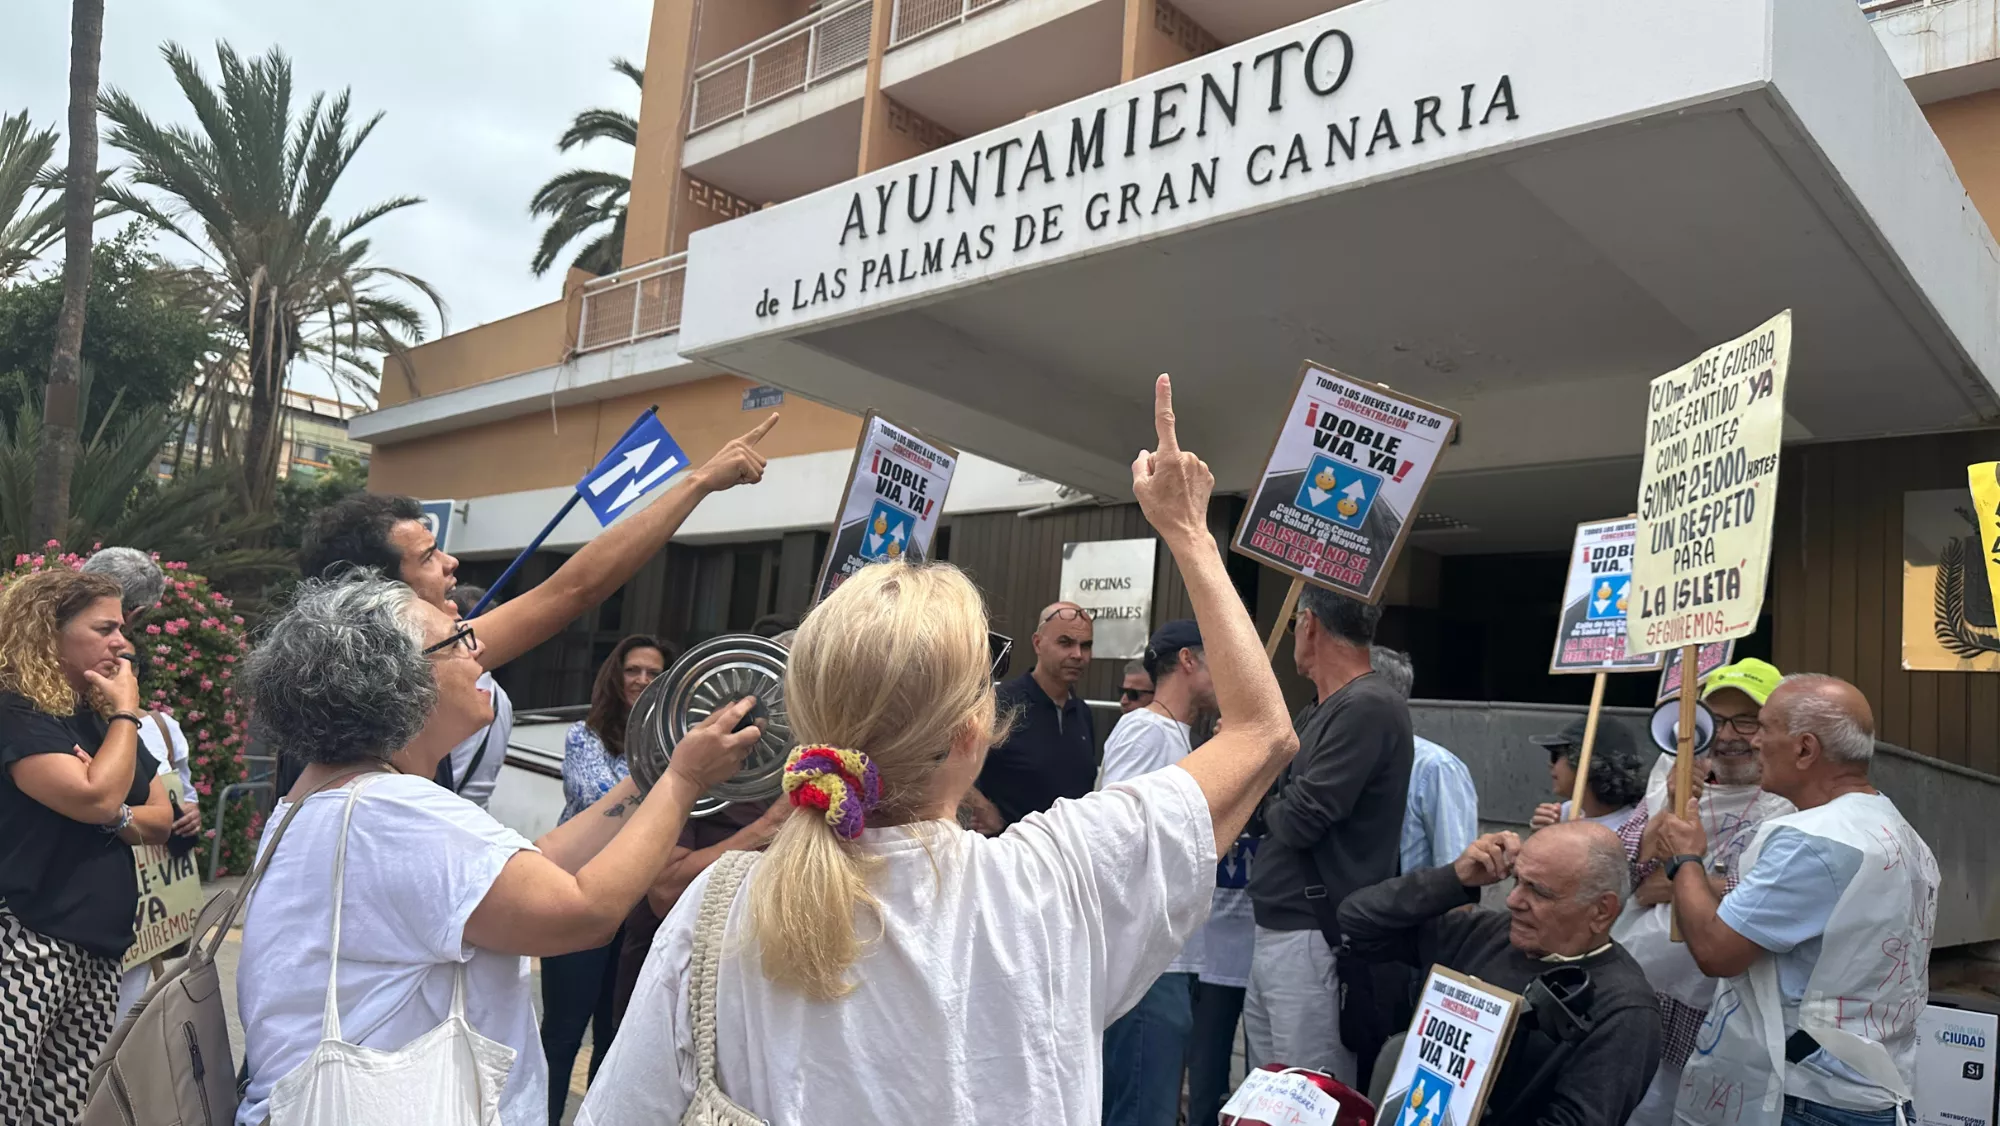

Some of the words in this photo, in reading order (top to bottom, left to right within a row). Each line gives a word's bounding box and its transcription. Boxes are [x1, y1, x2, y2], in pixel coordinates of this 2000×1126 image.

[839, 29, 1353, 245] AYUNTAMIENTO
[756, 288, 779, 318] de
[792, 268, 847, 310] LAS
[859, 225, 995, 292] PALMAS
[1013, 204, 1063, 252] DE
[1085, 156, 1219, 231] GRAN
[1246, 75, 1519, 186] CANARIA
[1722, 330, 1775, 379] GUERRA
[1315, 376, 1344, 394] TODOS
[1344, 387, 1361, 401] LOS
[1361, 394, 1391, 412] JUEVES
[1391, 405, 1398, 415] A
[1398, 408, 1416, 421] LAS
[1651, 405, 1683, 446] DOBLE
[1683, 382, 1739, 429] SENTIDO
[881, 424, 897, 441] TODOS
[1368, 450, 1414, 483] YA!
[1656, 438, 1687, 473] COMO
[908, 491, 935, 521] YA!
[1642, 470, 1687, 520] SOMOS
[1256, 517, 1276, 537] LA
[1275, 525, 1324, 557] ISLETA
[1324, 545, 1349, 564] NO
[1348, 553, 1370, 572] SE
[1269, 510, 1281, 520] de
[1282, 514, 1309, 532] Salud
[1308, 524, 1316, 535] y
[1317, 528, 1330, 540] de
[1330, 534, 1372, 555] Mayores
[1277, 503, 1301, 518] Calle
[1301, 513, 1314, 523] de
[1315, 519, 1331, 531] los
[1331, 525, 1369, 545] Centros
[1250, 531, 1287, 558] DEJA
[1285, 544, 1364, 587] ENCERRAR
[1673, 537, 1716, 574] PARA
[1080, 577, 1131, 591] OFICINAS
[1943, 1031, 1986, 1048] CIUDAD
[1447, 1051, 1475, 1088] YA!
